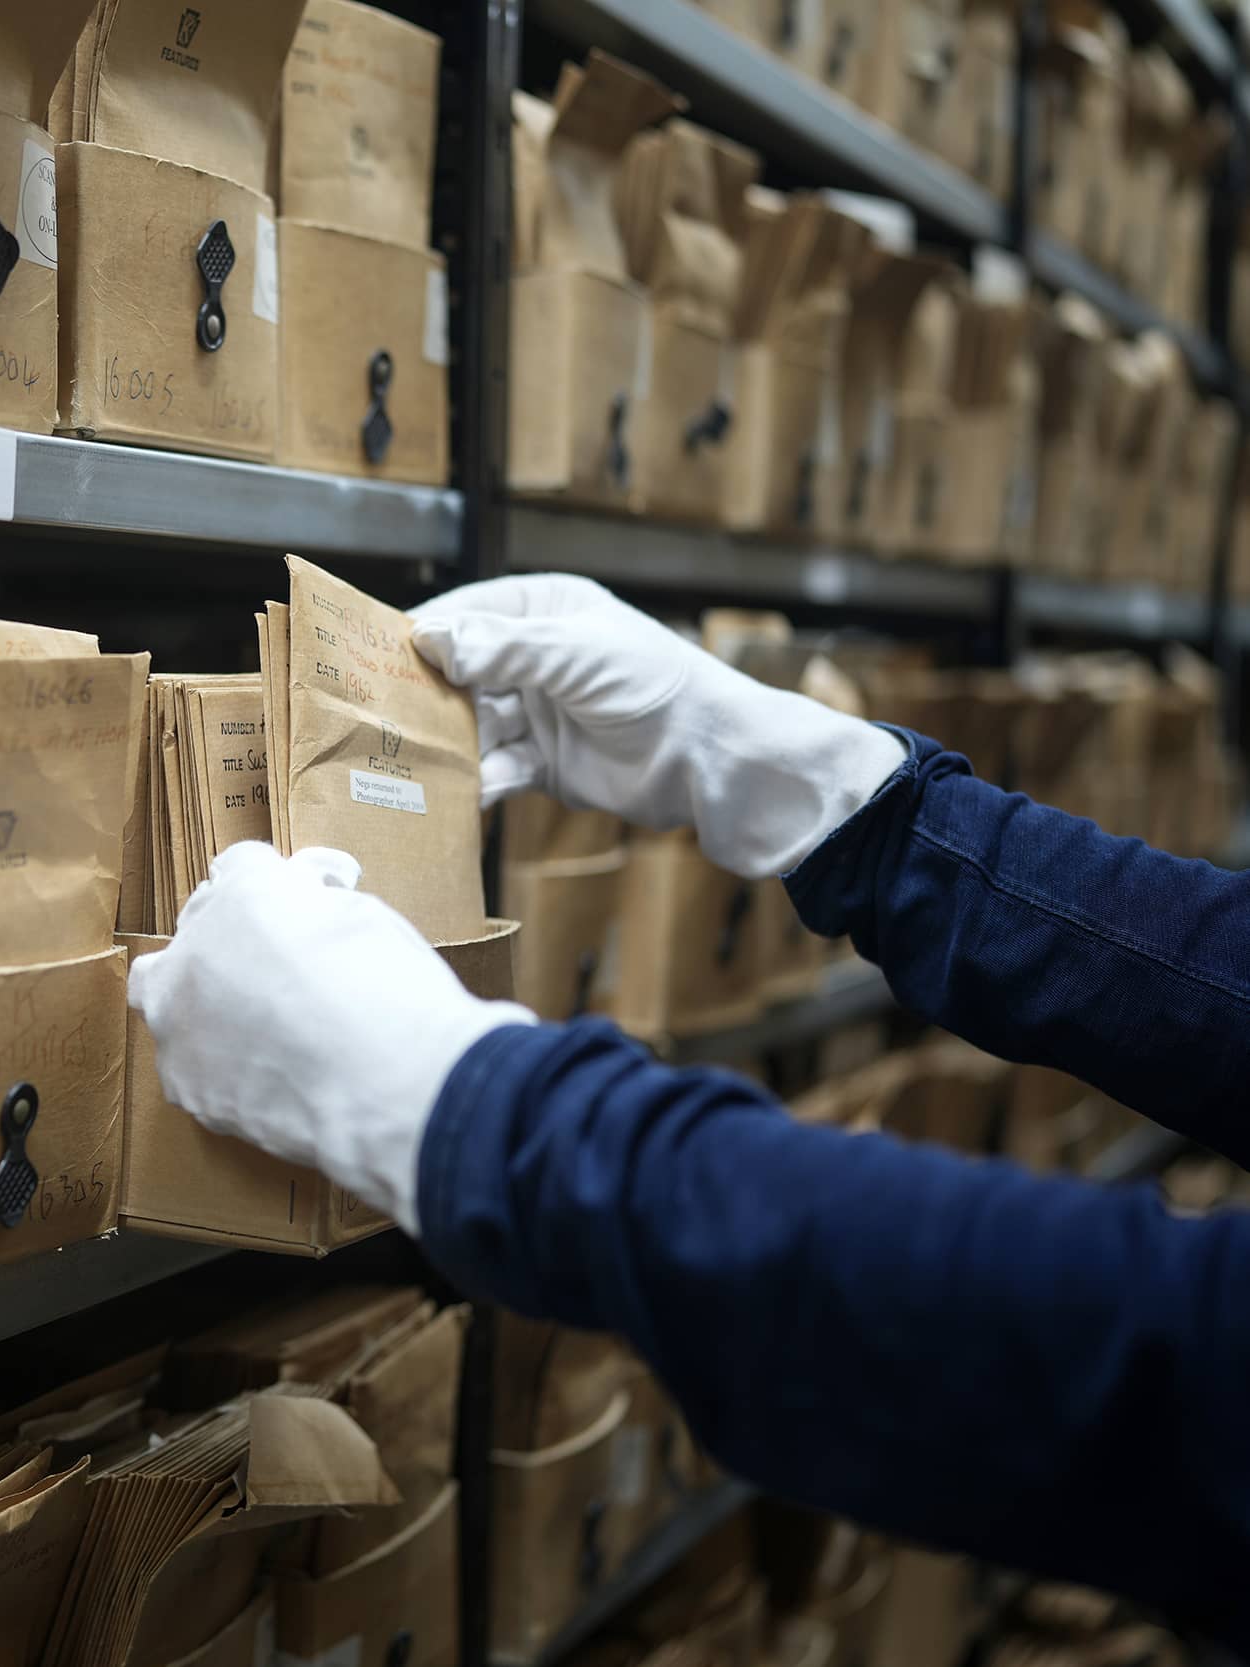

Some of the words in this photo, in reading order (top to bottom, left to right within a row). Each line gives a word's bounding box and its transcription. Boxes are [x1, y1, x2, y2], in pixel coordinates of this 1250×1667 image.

[160, 47, 199, 72] FEATURES
[103, 350, 174, 416] 16005
[315, 626, 338, 647] TITLE
[316, 661, 340, 681] DATE
[344, 671, 375, 704] 1962
[221, 722, 256, 735] NUMBER
[222, 759, 243, 771] TITLE
[368, 756, 412, 780] FEATURES
[225, 795, 246, 808] DATE
